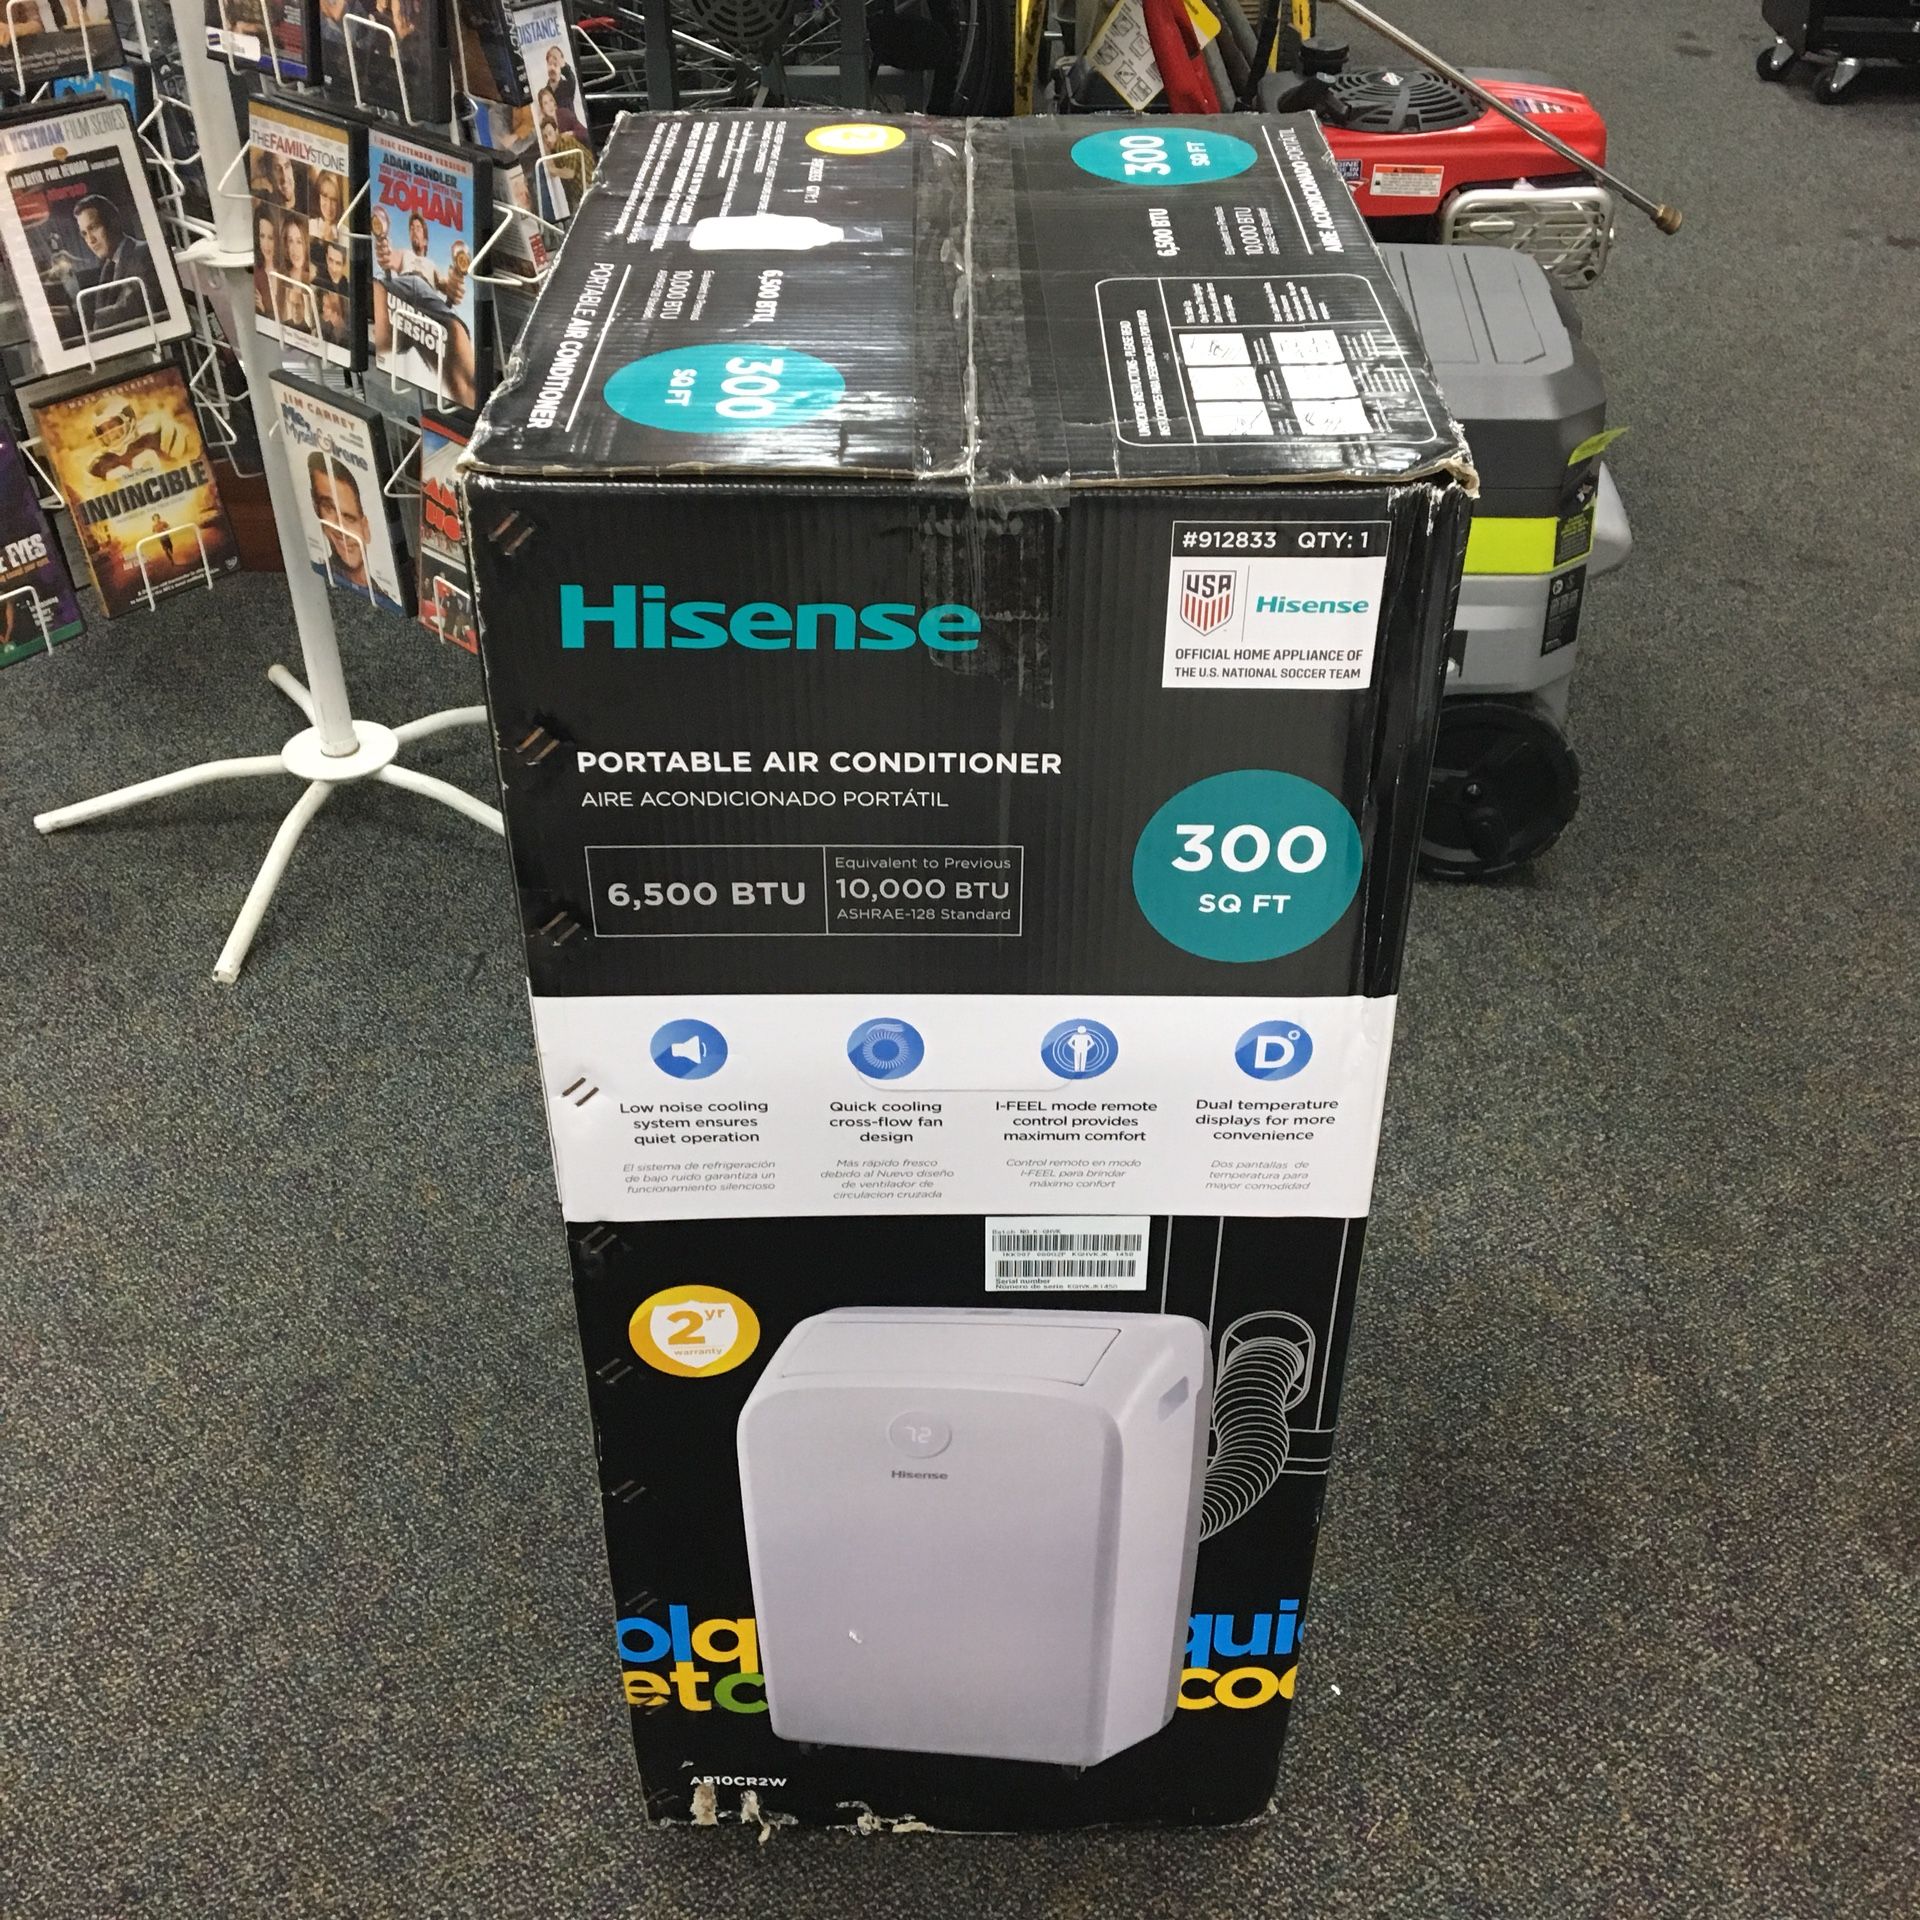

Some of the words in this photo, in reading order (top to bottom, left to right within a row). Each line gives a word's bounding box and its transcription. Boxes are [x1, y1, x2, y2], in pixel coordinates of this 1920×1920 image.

[64, 114, 91, 142] FILM
[91, 108, 127, 136] SERIES
[1186, 141, 1207, 152] FT
[1277, 127, 1307, 160] PORTÁTIL
[1119, 135, 1172, 175] 300
[1190, 152, 1211, 167] SQ
[383, 153, 412, 172] ADAM
[413, 163, 457, 188] SANDLER
[1291, 161, 1335, 228] ACONDICIONADO
[378, 174, 463, 232] ZOHAN
[1149, 208, 1172, 227] BTU
[1233, 206, 1256, 224] BTU
[1152, 229, 1181, 257] 6,500
[1238, 225, 1266, 255] 10,000
[1317, 230, 1345, 252] AIRE
[571, 262, 615, 317] PORTABLE
[664, 270, 694, 299] 10,000
[659, 301, 683, 320] BTU
[752, 301, 779, 322] BTU
[563, 317, 593, 339] AIR
[1119, 320, 1133, 335] READ
[1122, 336, 1137, 356] PLEASE
[526, 341, 583, 429] CONDITIONER
[670, 368, 697, 387] SQ
[715, 357, 784, 419] 300
[664, 390, 691, 406] FT
[283, 391, 304, 409] JIM
[307, 402, 355, 431] CARREY
[78, 459, 209, 525] INVINCIBLE
[1182, 530, 1277, 549] #912833
[1297, 531, 1354, 550] QTY:
[1360, 531, 1370, 549] 1
[5, 533, 48, 569] EYES
[1186, 574, 1232, 599] USA
[1255, 595, 1369, 614] Hisense
[560, 584, 982, 651] Hisense
[1175, 648, 1231, 661] OFFICIAL
[1234, 648, 1270, 661] HOME
[1272, 648, 1344, 662] APPLIANCE
[1346, 649, 1363, 662] OF
[1175, 666, 1196, 679] THE
[1199, 666, 1219, 679] U.S.
[1222, 667, 1278, 679] NATIONAL
[1281, 667, 1326, 679] SOCCER
[1329, 667, 1361, 679] TEAM
[576, 751, 752, 773] PORTABLE
[763, 751, 819, 773] AIR
[830, 752, 1062, 774] CONDITIONER
[581, 790, 634, 807] AIRE
[640, 790, 836, 807] ACONDICIONADO
[843, 787, 949, 807] PORTÁTIL
[1171, 824, 1327, 873] 300
[835, 856, 918, 871] Equivalent
[923, 858, 939, 869] to
[944, 856, 1011, 869] Previous
[607, 882, 718, 911] 6,500
[731, 882, 807, 906] BTU
[836, 878, 946, 903] 10,000
[955, 881, 1010, 899] BTU
[1198, 893, 1241, 915] SQ
[1253, 894, 1291, 914] FT
[837, 908, 936, 921] ASHRAE-128
[940, 907, 1011, 920] Standard
[620, 1102, 654, 1113] Low
[659, 1102, 703, 1113] noise
[708, 1101, 769, 1113] cooling
[830, 1101, 877, 1113] Quick
[882, 1101, 942, 1114] cooling
[996, 1101, 1047, 1112] I-FEEL
[1052, 1101, 1097, 1112] mode
[1101, 1101, 1157, 1112] remote
[1196, 1099, 1233, 1110] Dual
[1237, 1099, 1339, 1113] temperature
[633, 1118, 691, 1130] system
[695, 1117, 758, 1128] ensures
[829, 1116, 913, 1127] cross-flow
[918, 1116, 943, 1127] fan
[1013, 1116, 1068, 1127] control
[1072, 1116, 1138, 1130] provides
[1195, 1115, 1260, 1127] displays
[1265, 1114, 1289, 1126] for
[1293, 1115, 1336, 1126] more
[634, 1132, 676, 1146] quiet
[681, 1131, 760, 1145] operation
[859, 1131, 913, 1143] design
[1004, 1131, 1080, 1142] maximum
[1084, 1130, 1146, 1142] comfort
[1213, 1130, 1314, 1141] convenience
[639, 1162, 681, 1172] sistema
[684, 1161, 699, 1171] de
[702, 1160, 775, 1172] refrigeración
[902, 1158, 938, 1168] fresco
[1006, 1158, 1047, 1168] Control
[1049, 1159, 1089, 1168] remoto
[1092, 1160, 1105, 1168] en
[1108, 1158, 1142, 1168] modo
[1211, 1160, 1232, 1169] Dos
[1235, 1160, 1288, 1171] pantallas
[1294, 1160, 1310, 1169] de
[625, 1174, 640, 1183] de
[643, 1173, 669, 1184] bajo
[671, 1172, 702, 1182] ruido
[705, 1172, 758, 1183] garantiza
[820, 1169, 861, 1179] debido
[864, 1169, 874, 1178] al
[877, 1169, 914, 1178] Nuevo
[1020, 1169, 1055, 1178] I-FEEL
[1058, 1171, 1083, 1180] para
[1086, 1169, 1127, 1178] brindar
[1209, 1171, 1280, 1182] temperatura
[1282, 1172, 1309, 1181] para
[627, 1183, 717, 1193] funcionamiento
[720, 1182, 776, 1192] silencioso
[841, 1180, 856, 1189] de
[859, 1179, 917, 1189] ventilador
[918, 1179, 934, 1189] de
[1076, 1179, 1116, 1188] confort
[1205, 1182, 1241, 1192] mayor
[1244, 1181, 1311, 1191] comodidad
[896, 1190, 943, 1199] cruzada
[667, 1310, 706, 1345] 2
[705, 1306, 726, 1320] yr
[674, 1347, 722, 1356] warranty
[891, 1470, 948, 1480] Hisense
[690, 1775, 787, 1787] AP10CR2W
